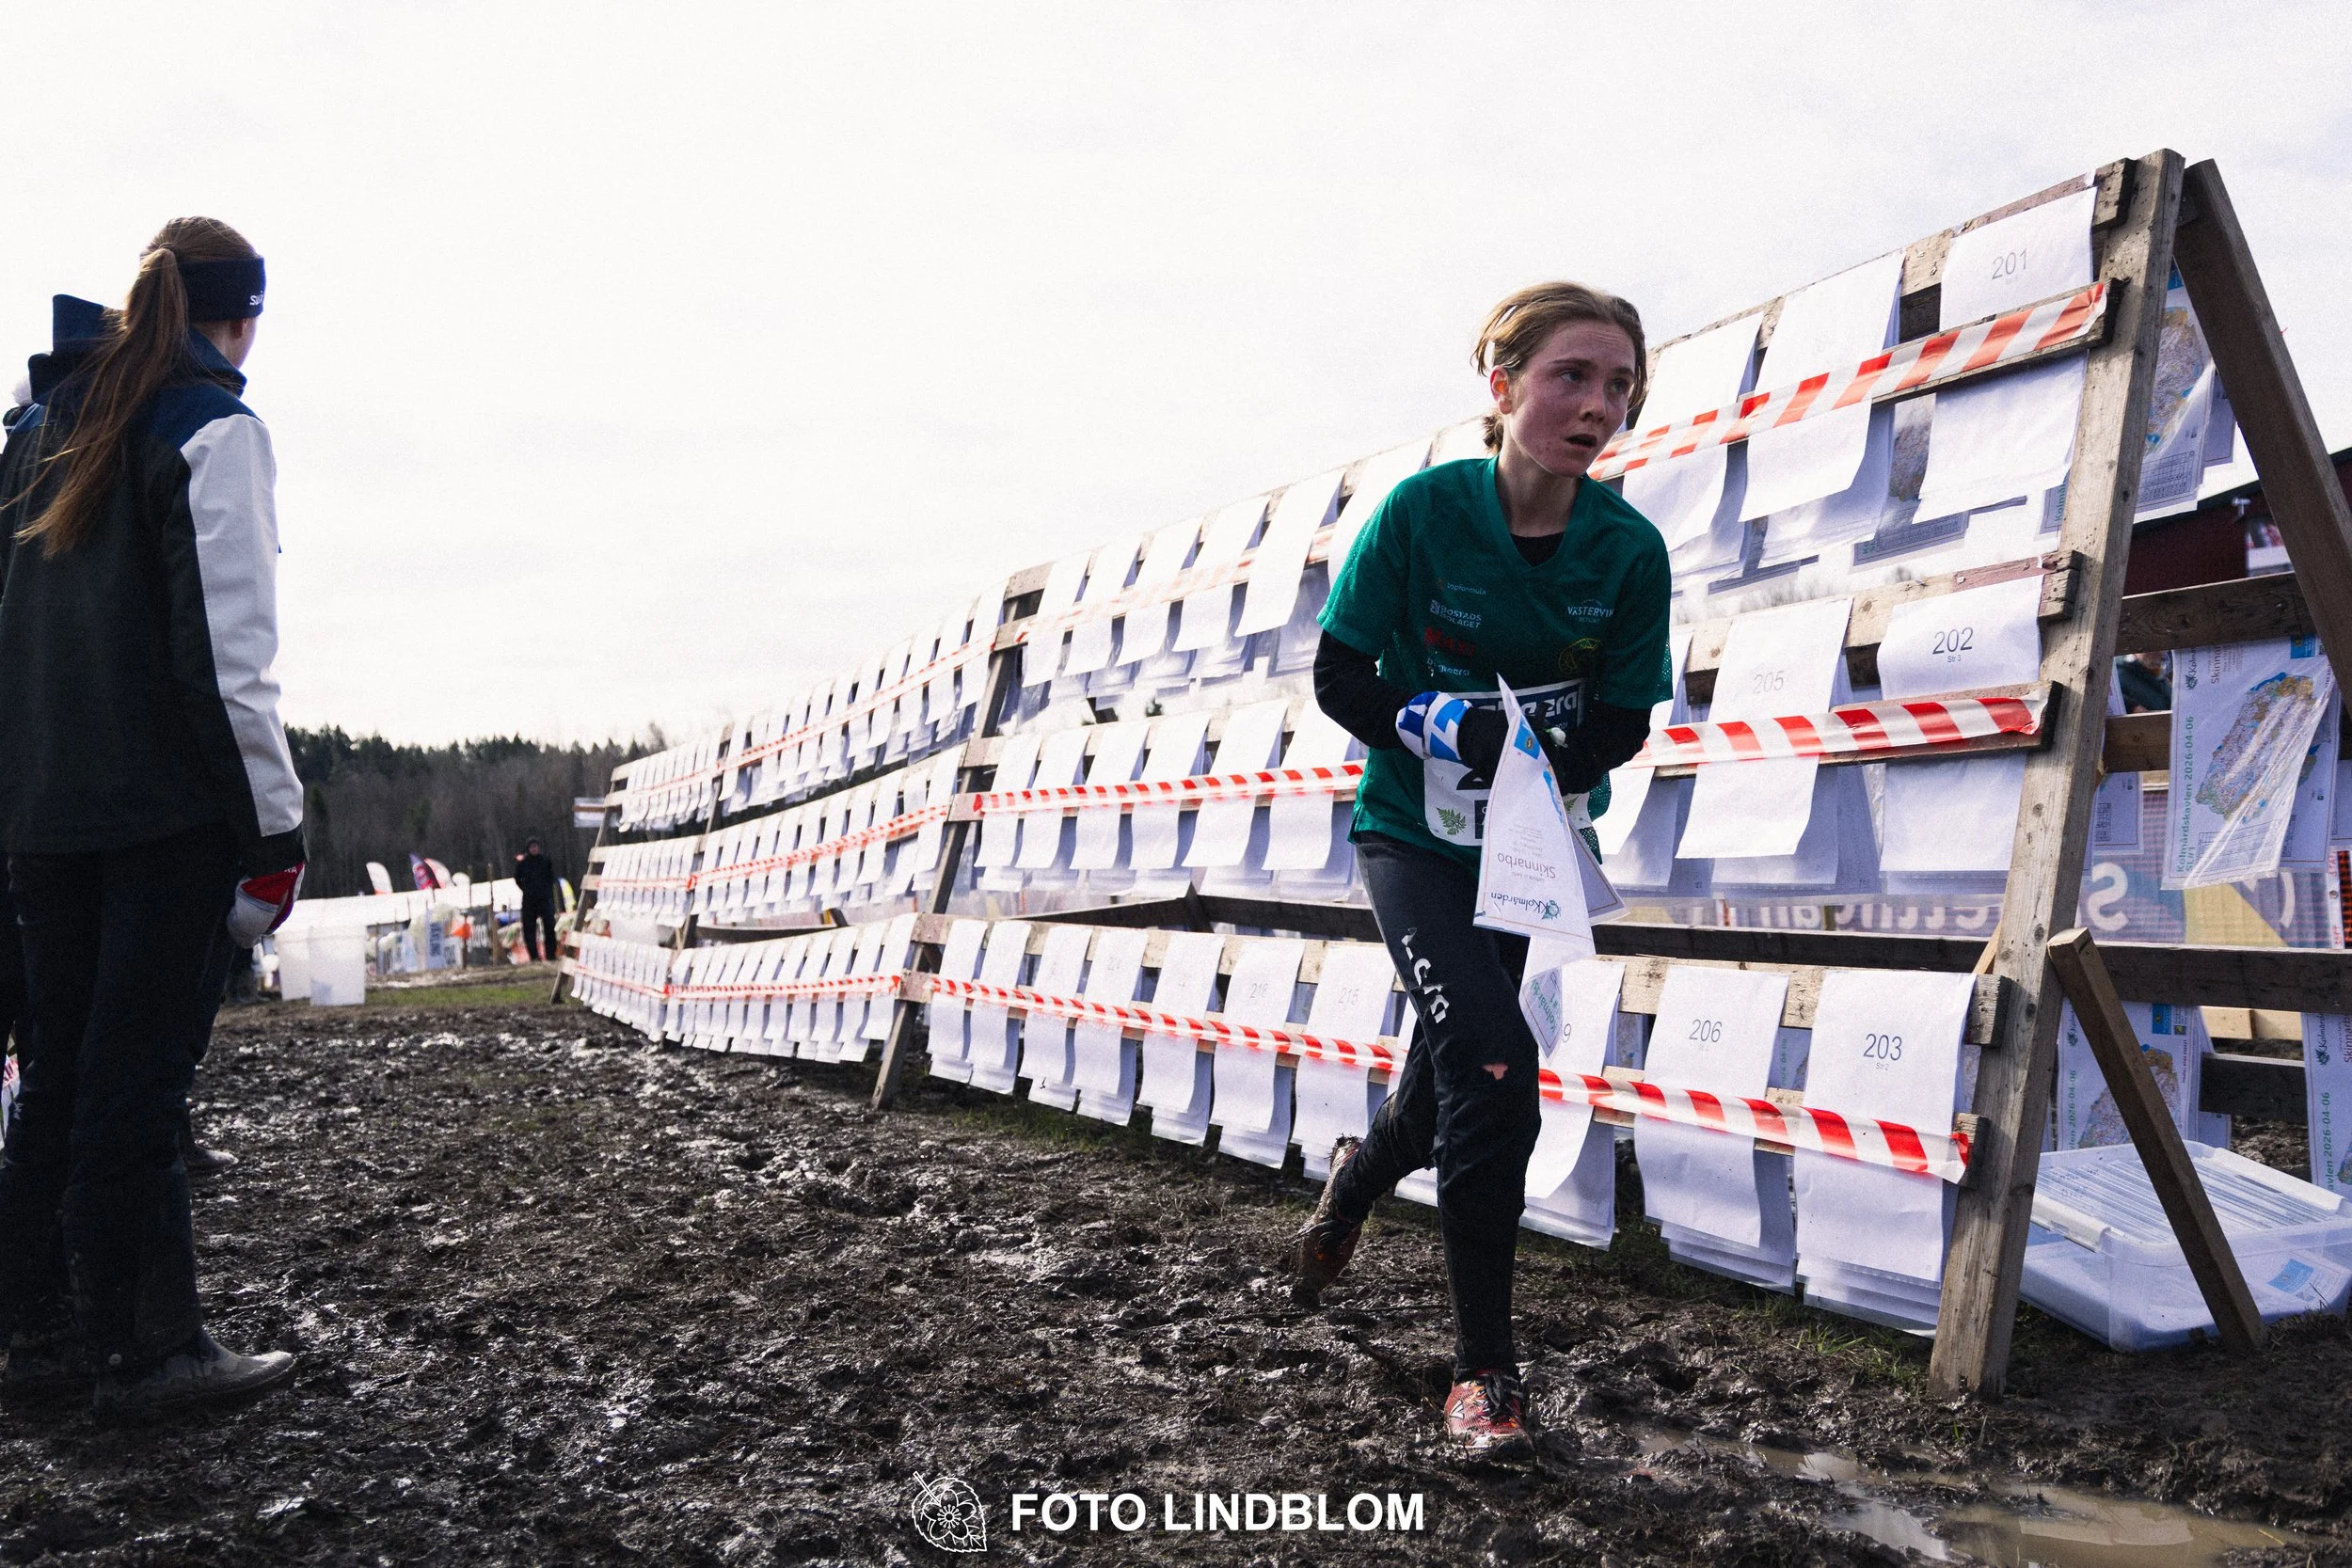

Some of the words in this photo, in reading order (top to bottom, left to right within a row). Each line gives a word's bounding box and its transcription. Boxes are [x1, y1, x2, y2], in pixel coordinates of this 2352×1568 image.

[1992, 248, 2026, 280] 201
[1440, 604, 1482, 621] BOSTADS
[1932, 626, 1974, 655] 202
[1753, 670, 1785, 694] 205
[2184, 715, 2195, 780] 2026-04-06
[2176, 782, 2193, 873] Kolmårdskavlen
[1497, 852, 1557, 879] Skinnarbo
[1689, 1019, 1723, 1043] 206
[1863, 1032, 1903, 1062] 203
[2320, 1091, 2332, 1157] 2026-04-06
